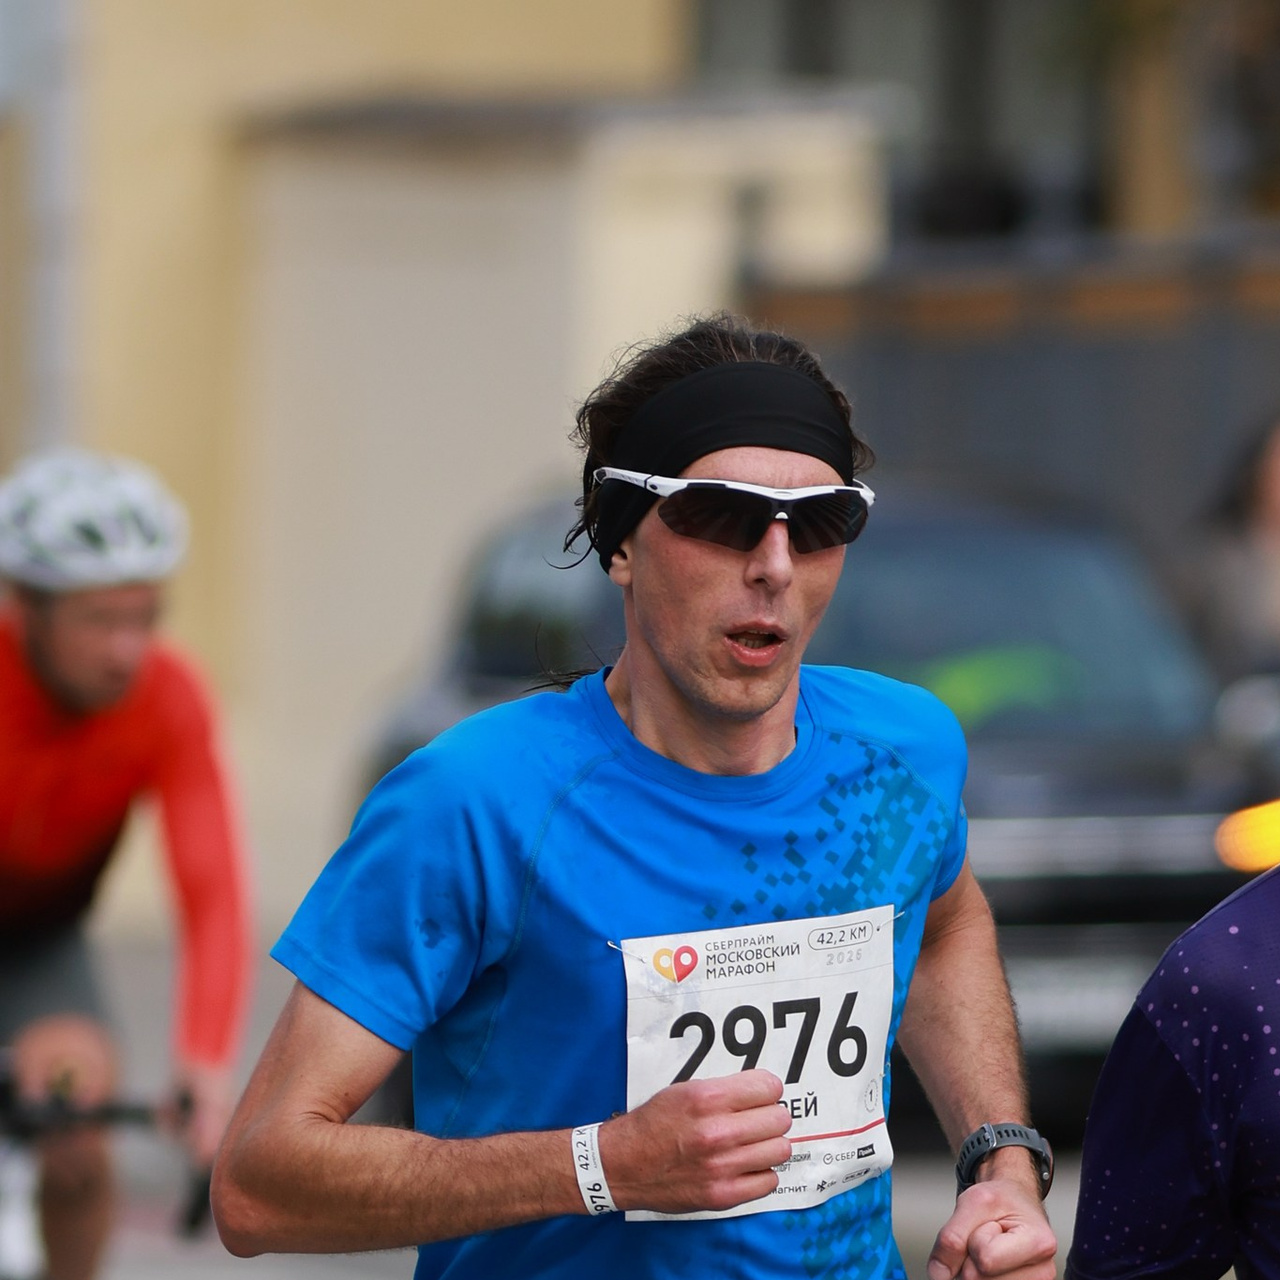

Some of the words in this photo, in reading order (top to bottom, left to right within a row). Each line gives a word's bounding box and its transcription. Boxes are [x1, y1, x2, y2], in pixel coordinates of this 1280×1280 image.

[705, 934, 775, 952] СБЕРПРАЙМ
[816, 930, 846, 946] 42,2
[850, 925, 867, 941] КМ
[706, 942, 801, 966] МОСКОВСКИЙ
[706, 961, 776, 980] МАРАФОН
[669, 991, 868, 1085] 2976
[576, 1140, 590, 1171] 42,2
[835, 1151, 856, 1162] СБЕР
